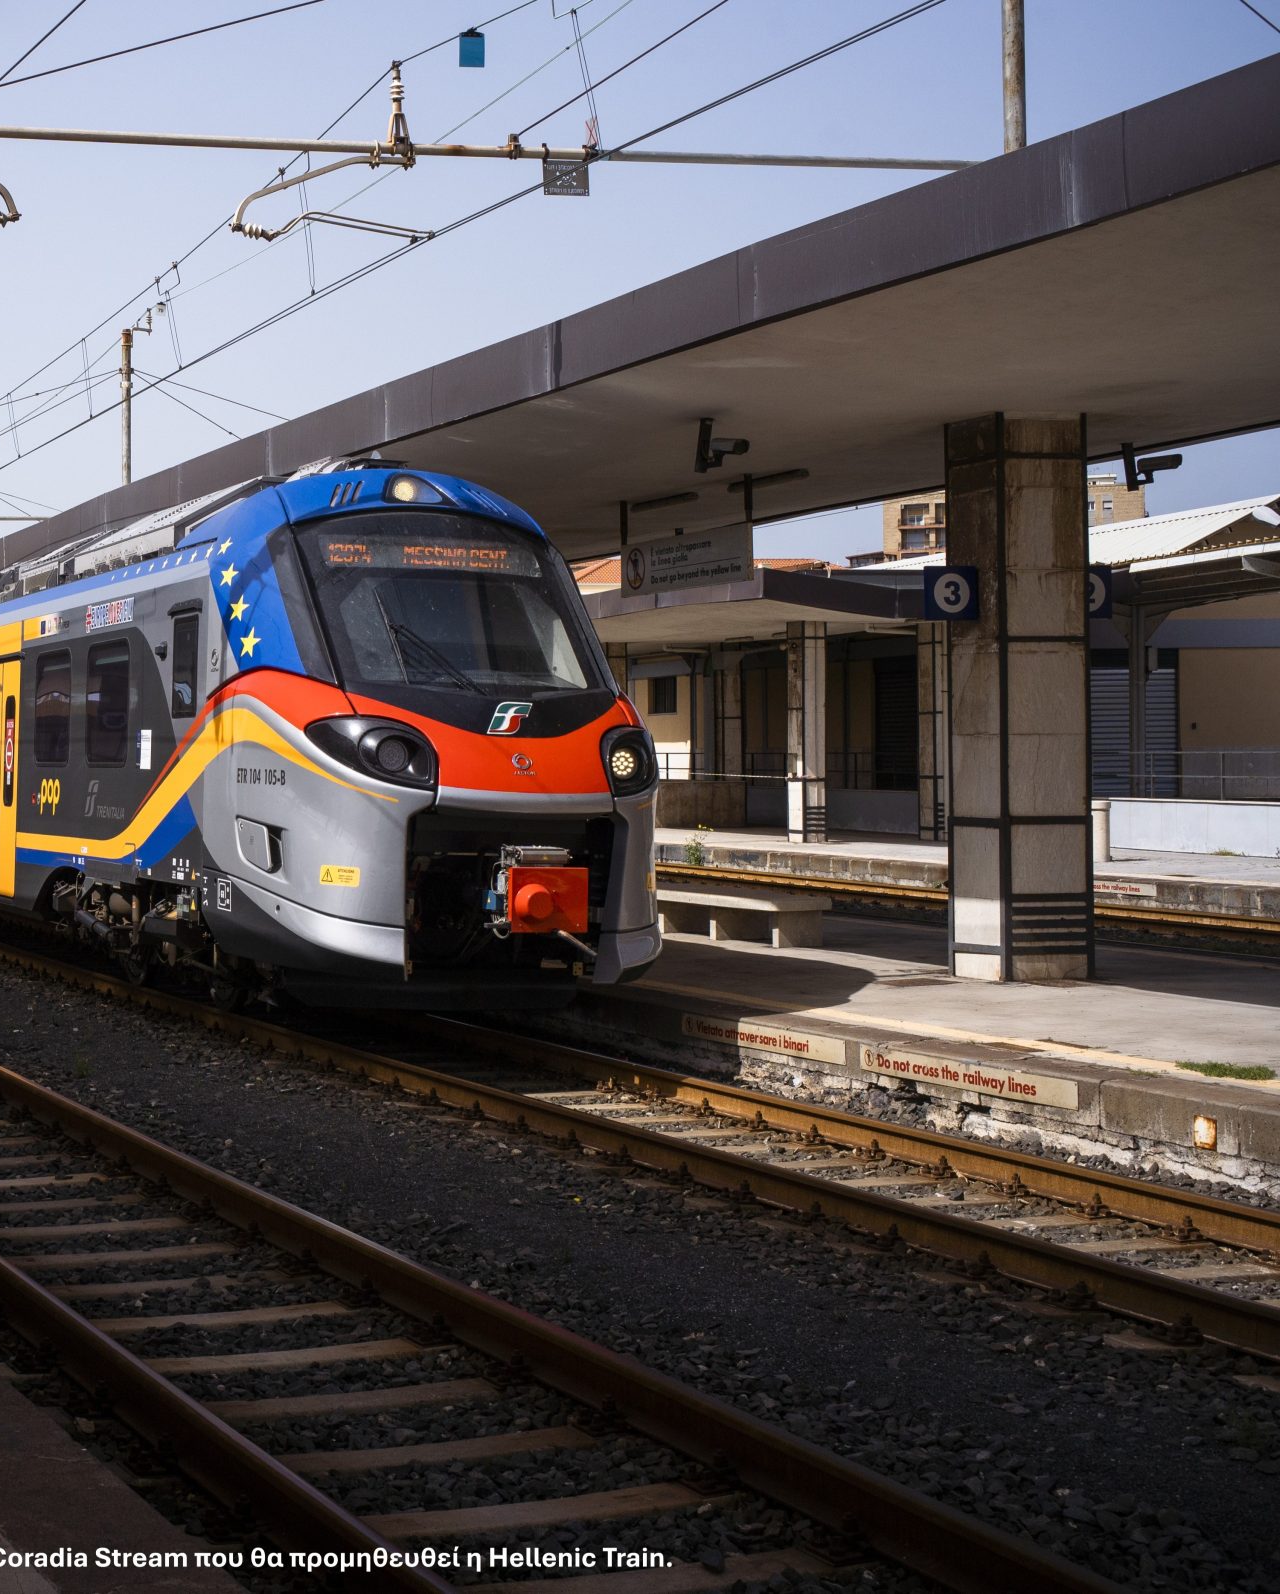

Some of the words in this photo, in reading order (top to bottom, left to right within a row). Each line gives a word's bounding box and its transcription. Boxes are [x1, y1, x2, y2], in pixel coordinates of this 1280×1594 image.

[651, 575, 659, 585] Do
[659, 574, 668, 583] not
[669, 575, 677, 584] go
[677, 567, 699, 583] beyond
[700, 567, 710, 577] the
[711, 563, 729, 576] yellow
[730, 562, 741, 573] line
[943, 581, 962, 606] 3
[236, 767, 248, 784] ETR
[249, 768, 261, 785] 104
[264, 768, 286, 786] 105-B
[40, 778, 61, 816] pop
[96, 805, 126, 821] TRENITALIA
[1110, 884, 1128, 893] railway
[1128, 884, 1140, 892] lines
[696, 1019, 723, 1037] Vietato
[725, 1029, 777, 1047] attraversare
[778, 1035, 782, 1048] i
[783, 1035, 809, 1053] binari
[876, 1053, 890, 1070] Do
[893, 1059, 910, 1072] not
[912, 1064, 939, 1079] cross
[941, 1065, 959, 1081] the
[963, 1070, 1005, 1094] railway
[1007, 1076, 1037, 1097] lines
